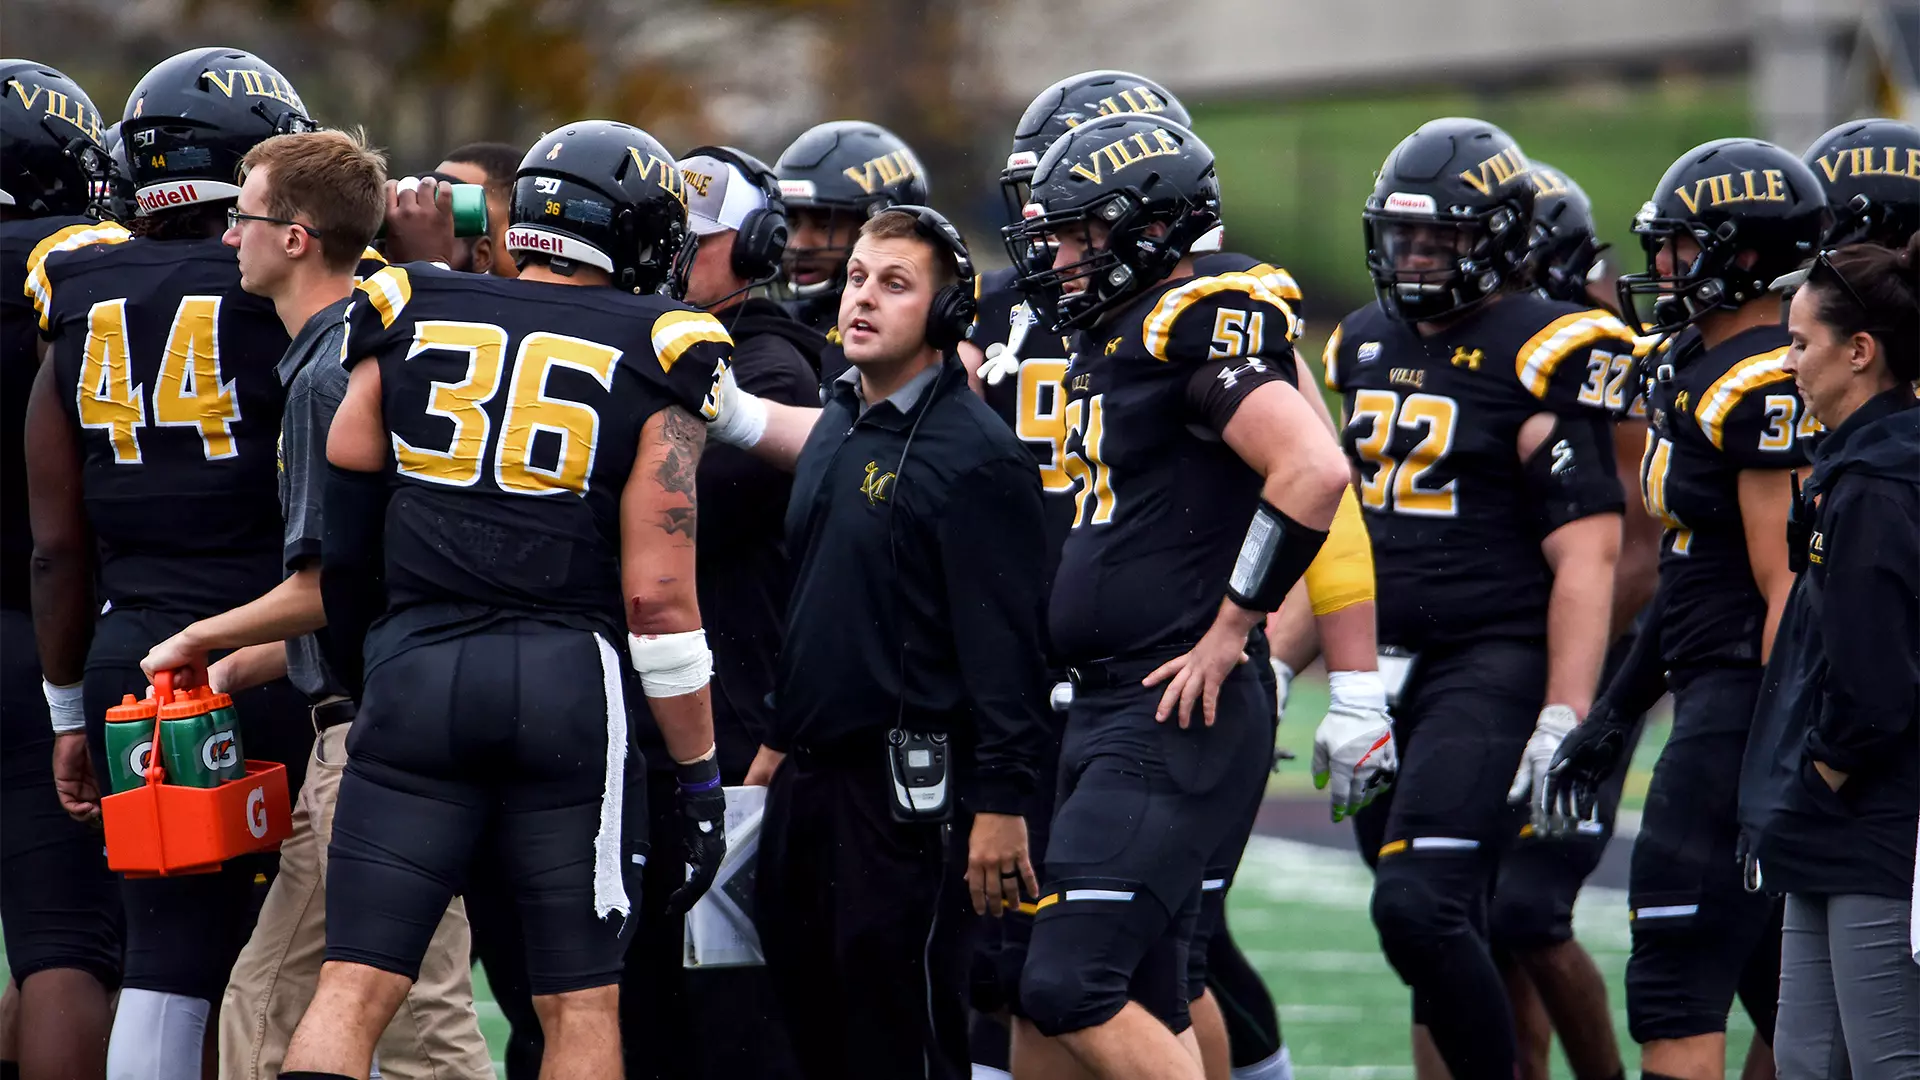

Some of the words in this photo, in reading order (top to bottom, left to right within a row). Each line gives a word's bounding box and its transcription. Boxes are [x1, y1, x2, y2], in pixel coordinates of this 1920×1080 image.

[1065, 86, 1164, 128] LLE
[151, 154, 166, 168] 44
[1069, 128, 1181, 185] VILLE
[1816, 146, 1920, 184] VILLE
[137, 184, 198, 212] Riddell
[681, 169, 712, 197] VILLE
[1675, 169, 1785, 215] VILLE
[545, 201, 561, 215] 36
[508, 231, 563, 254] Riddell
[1207, 307, 1263, 360] 51
[76, 295, 242, 464] 44
[1389, 367, 1425, 389] VILLE
[1577, 349, 1633, 410] 32
[391, 320, 624, 498] 36
[1348, 389, 1458, 516] 32
[246, 786, 268, 838] G
